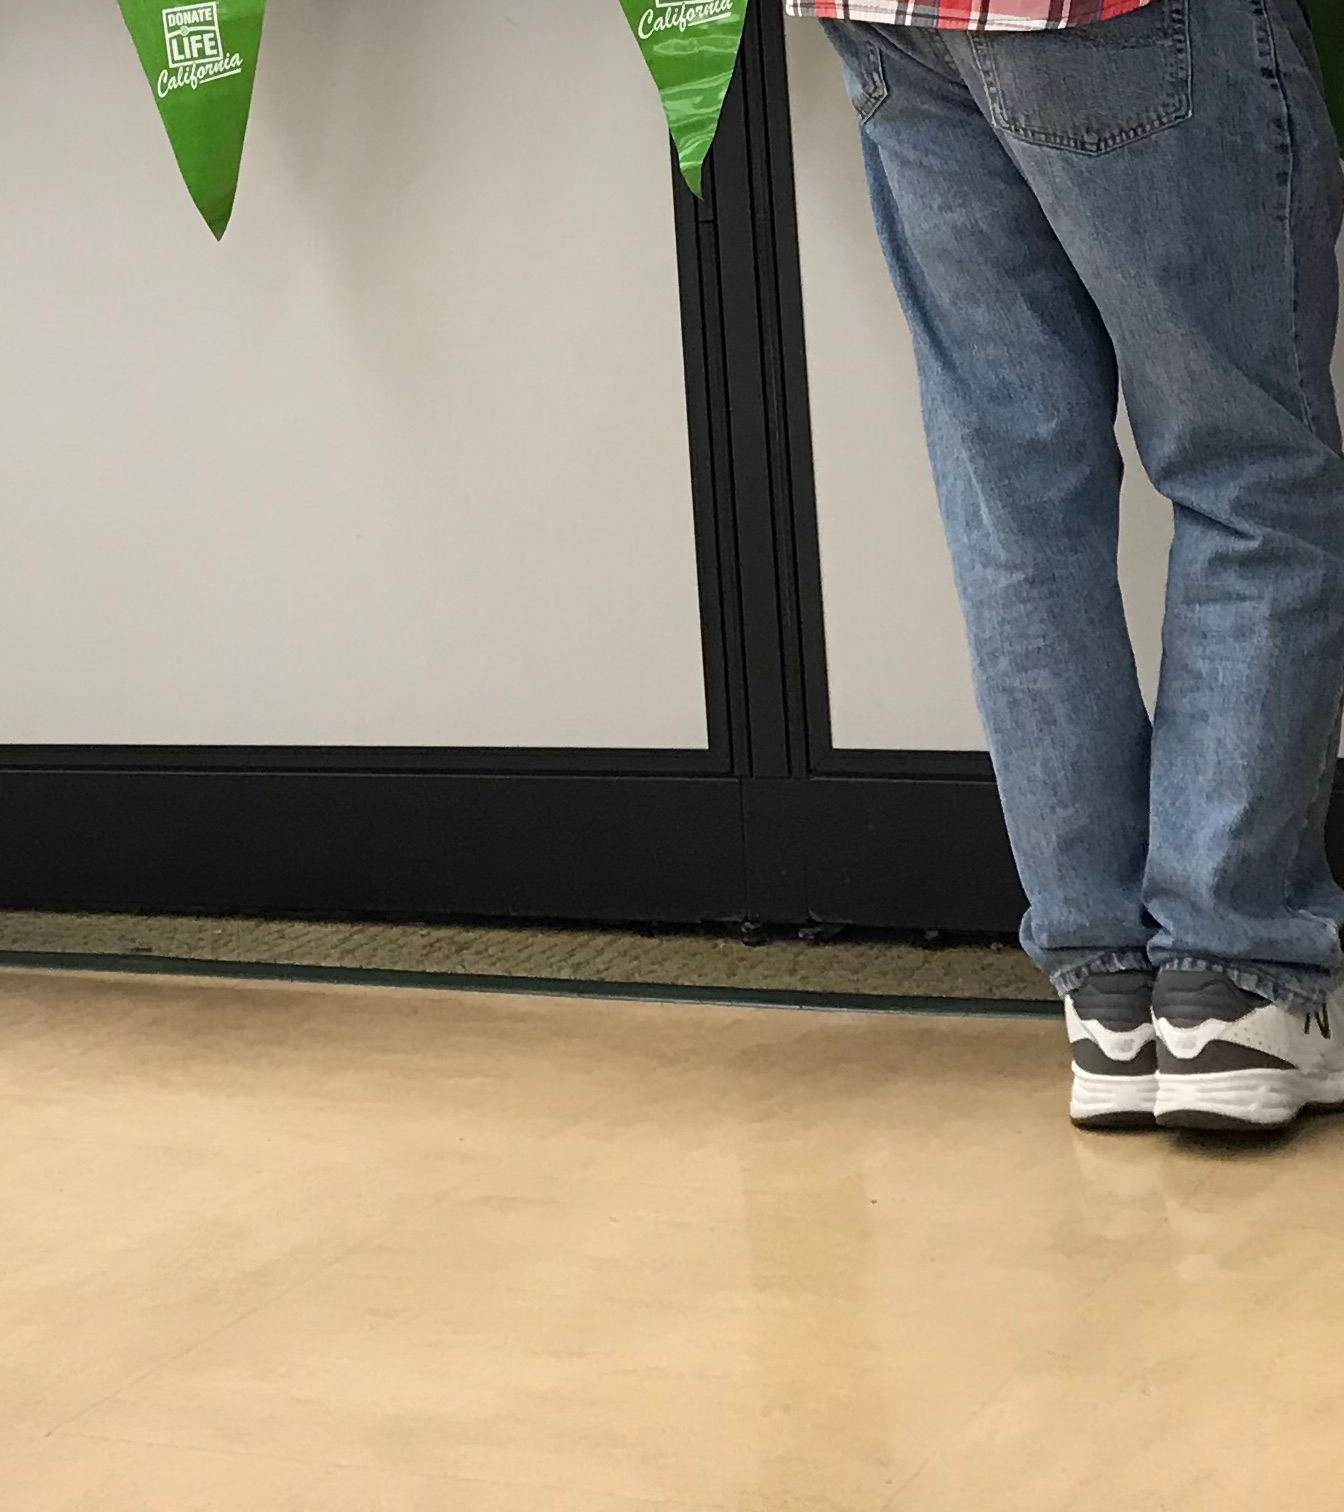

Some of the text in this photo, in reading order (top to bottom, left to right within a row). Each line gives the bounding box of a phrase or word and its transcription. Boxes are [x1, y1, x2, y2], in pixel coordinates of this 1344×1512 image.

[168, 8, 212, 27] DONATE
[171, 32, 219, 61] LIFE
[157, 52, 243, 99] California
